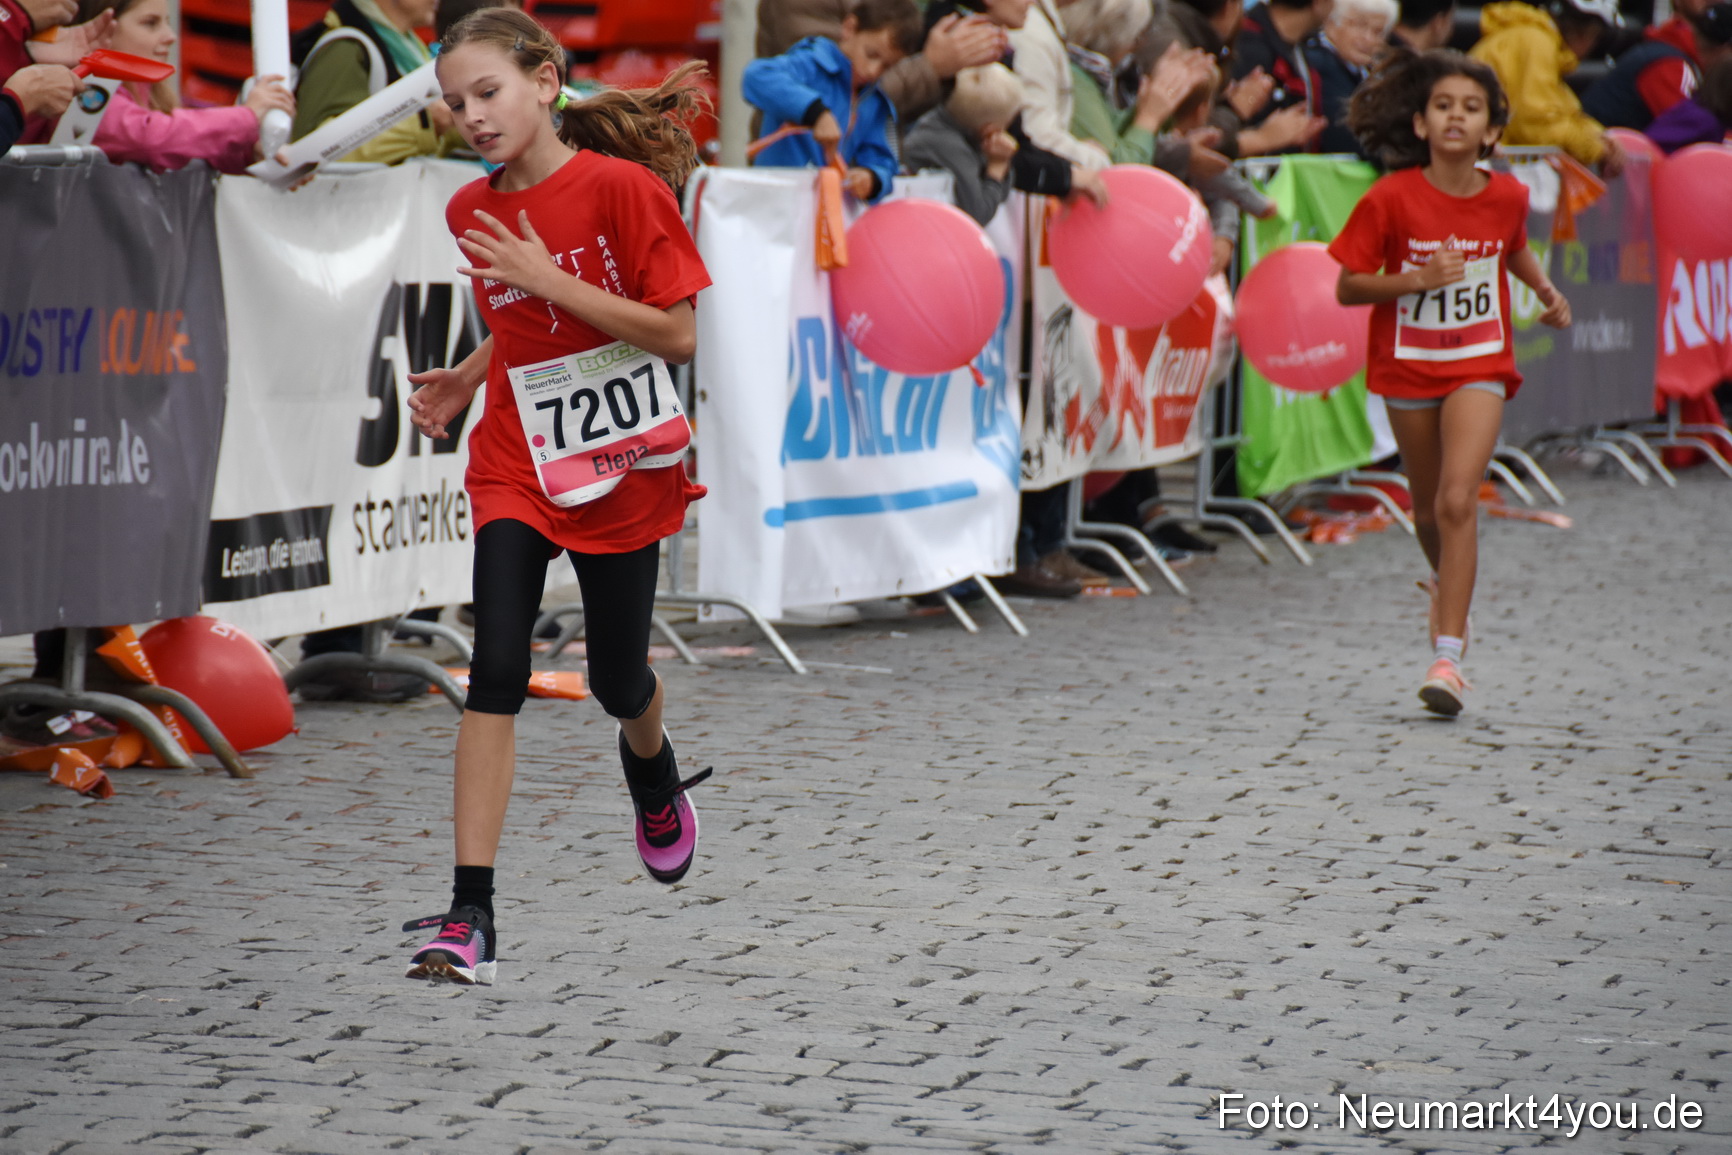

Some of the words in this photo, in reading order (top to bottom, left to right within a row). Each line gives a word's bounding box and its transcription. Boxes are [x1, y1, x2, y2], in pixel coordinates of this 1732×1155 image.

[1412, 282, 1491, 323] 7156
[524, 373, 573, 392] NeuerMarkt
[535, 362, 660, 450] 7207
[672, 405, 680, 415] K
[540, 451, 548, 462] 5
[592, 445, 649, 476] Elena
